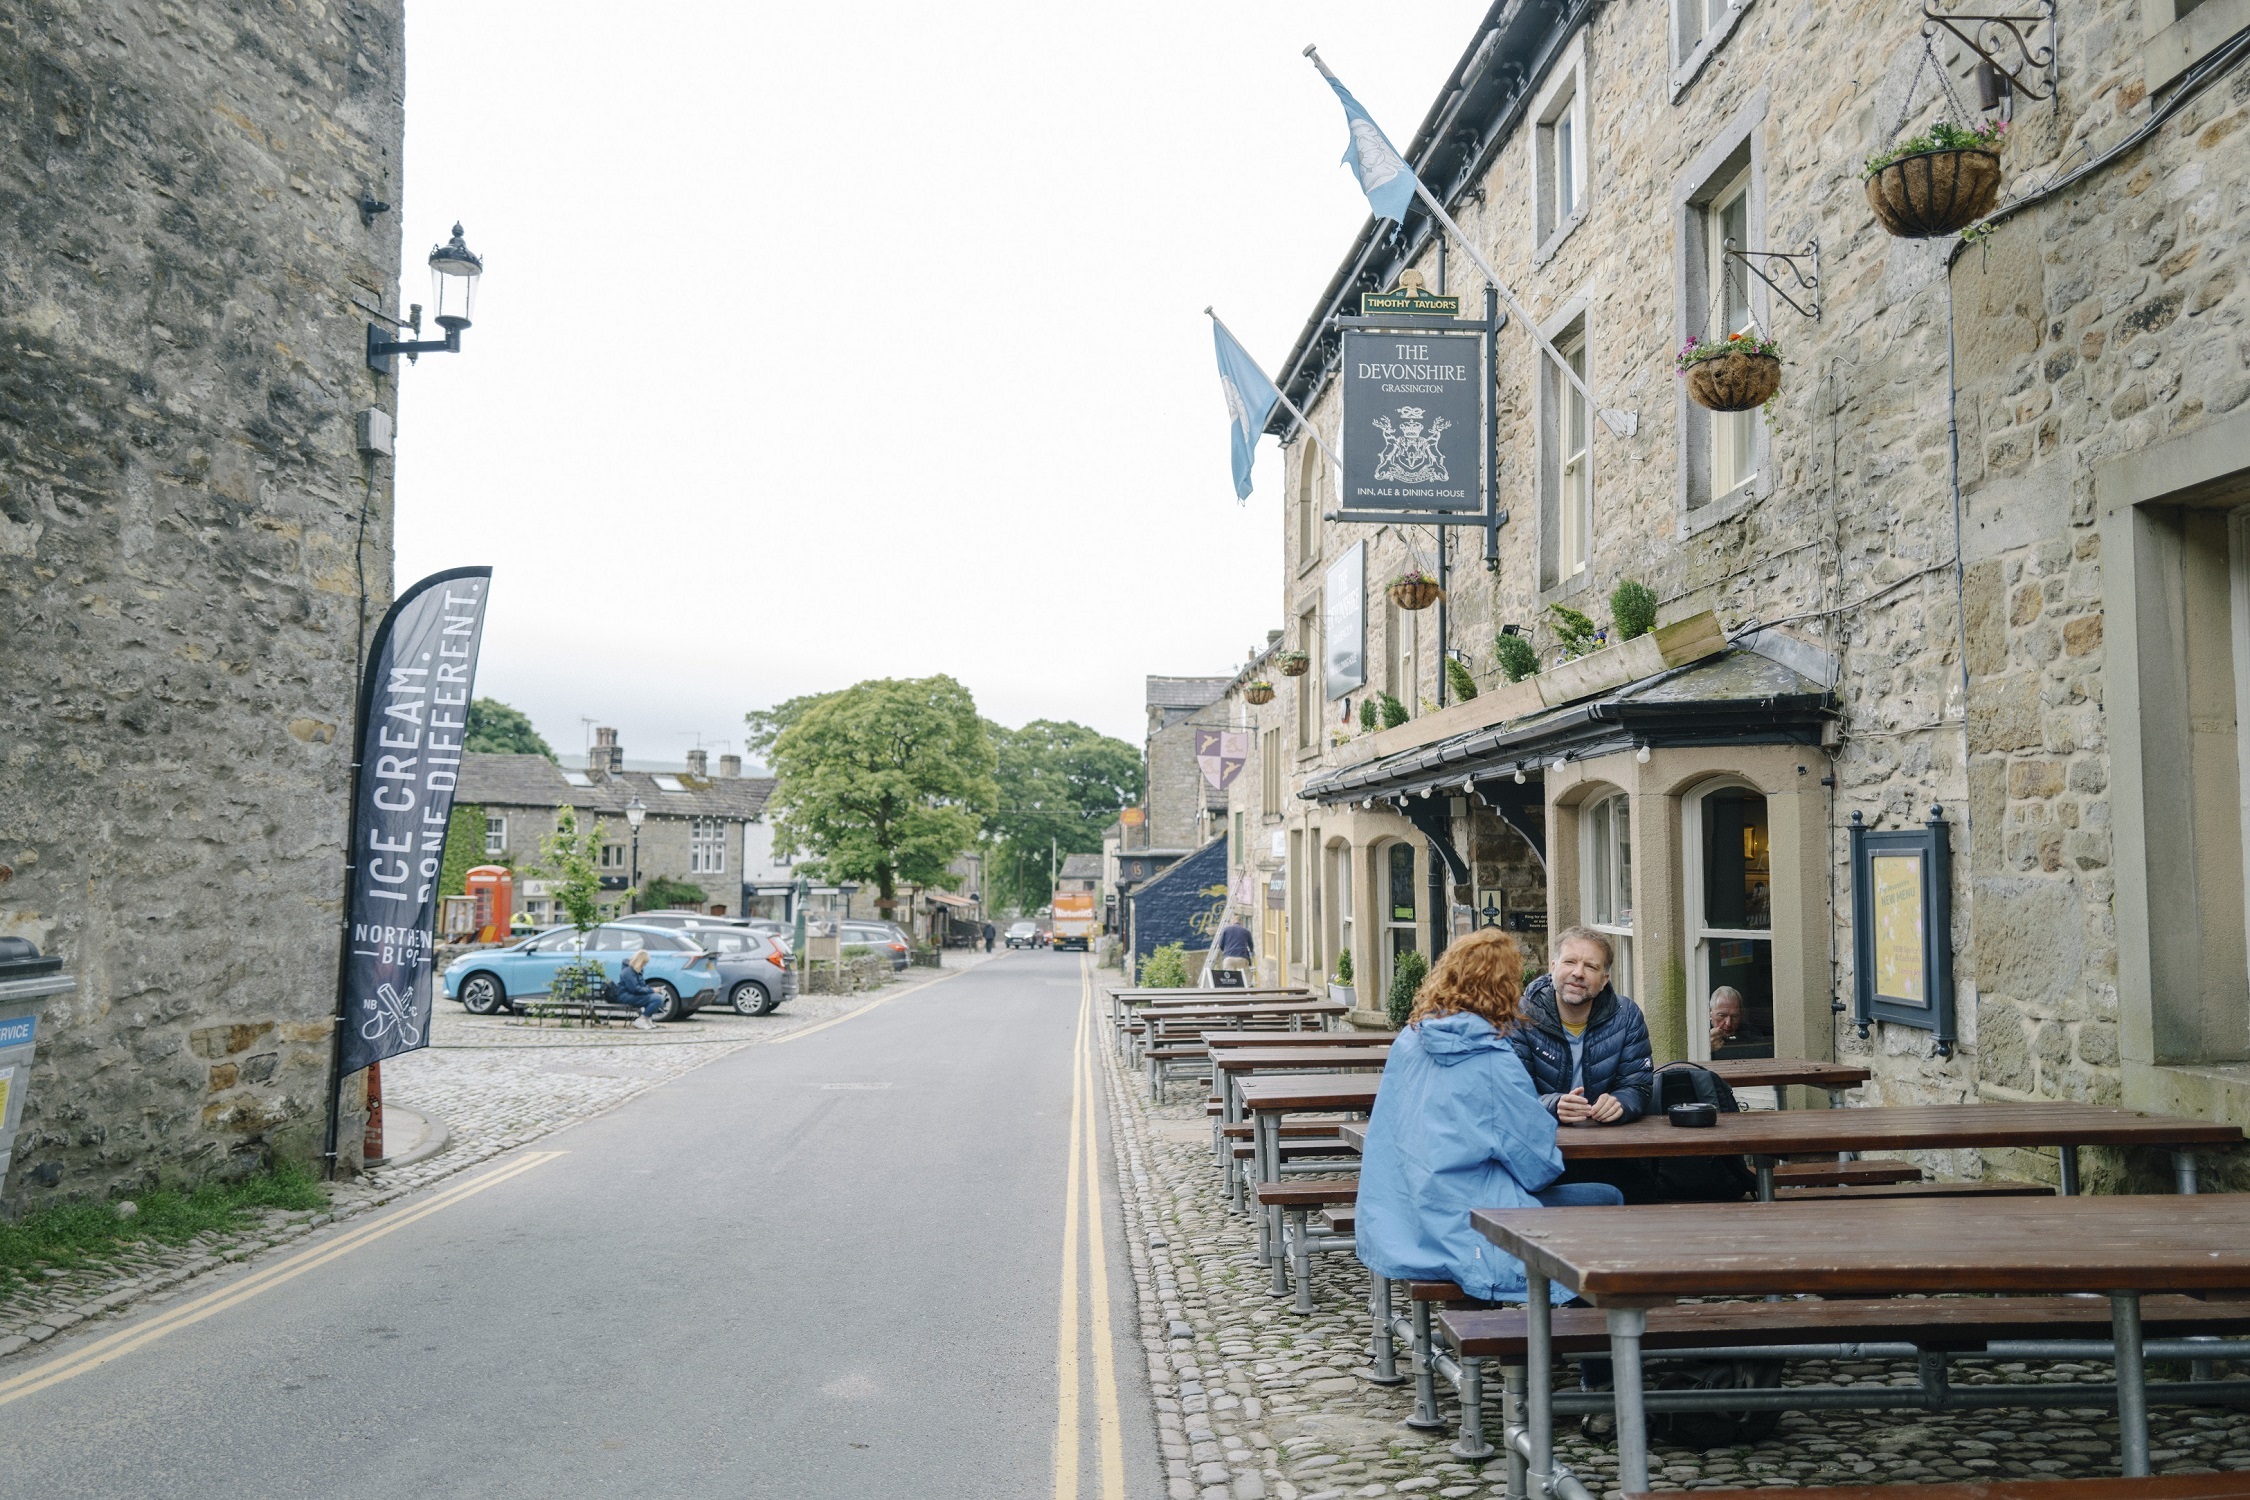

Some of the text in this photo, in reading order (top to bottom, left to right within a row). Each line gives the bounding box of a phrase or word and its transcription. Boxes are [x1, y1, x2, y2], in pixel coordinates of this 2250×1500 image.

[1367, 298, 1457, 310] TIMOTHY TAYLOR'S
[1395, 344, 1429, 360] THE
[1358, 363, 1467, 381] DEVONSHIRE
[1381, 383, 1444, 393] GRASSINGTON
[1357, 487, 1465, 498] INN, ALE & DINING HOUSE
[426, 584, 479, 792] DIFFERENT.
[368, 652, 431, 901] ICE CREAM.
[1881, 887, 1916, 907] NEW MENU
